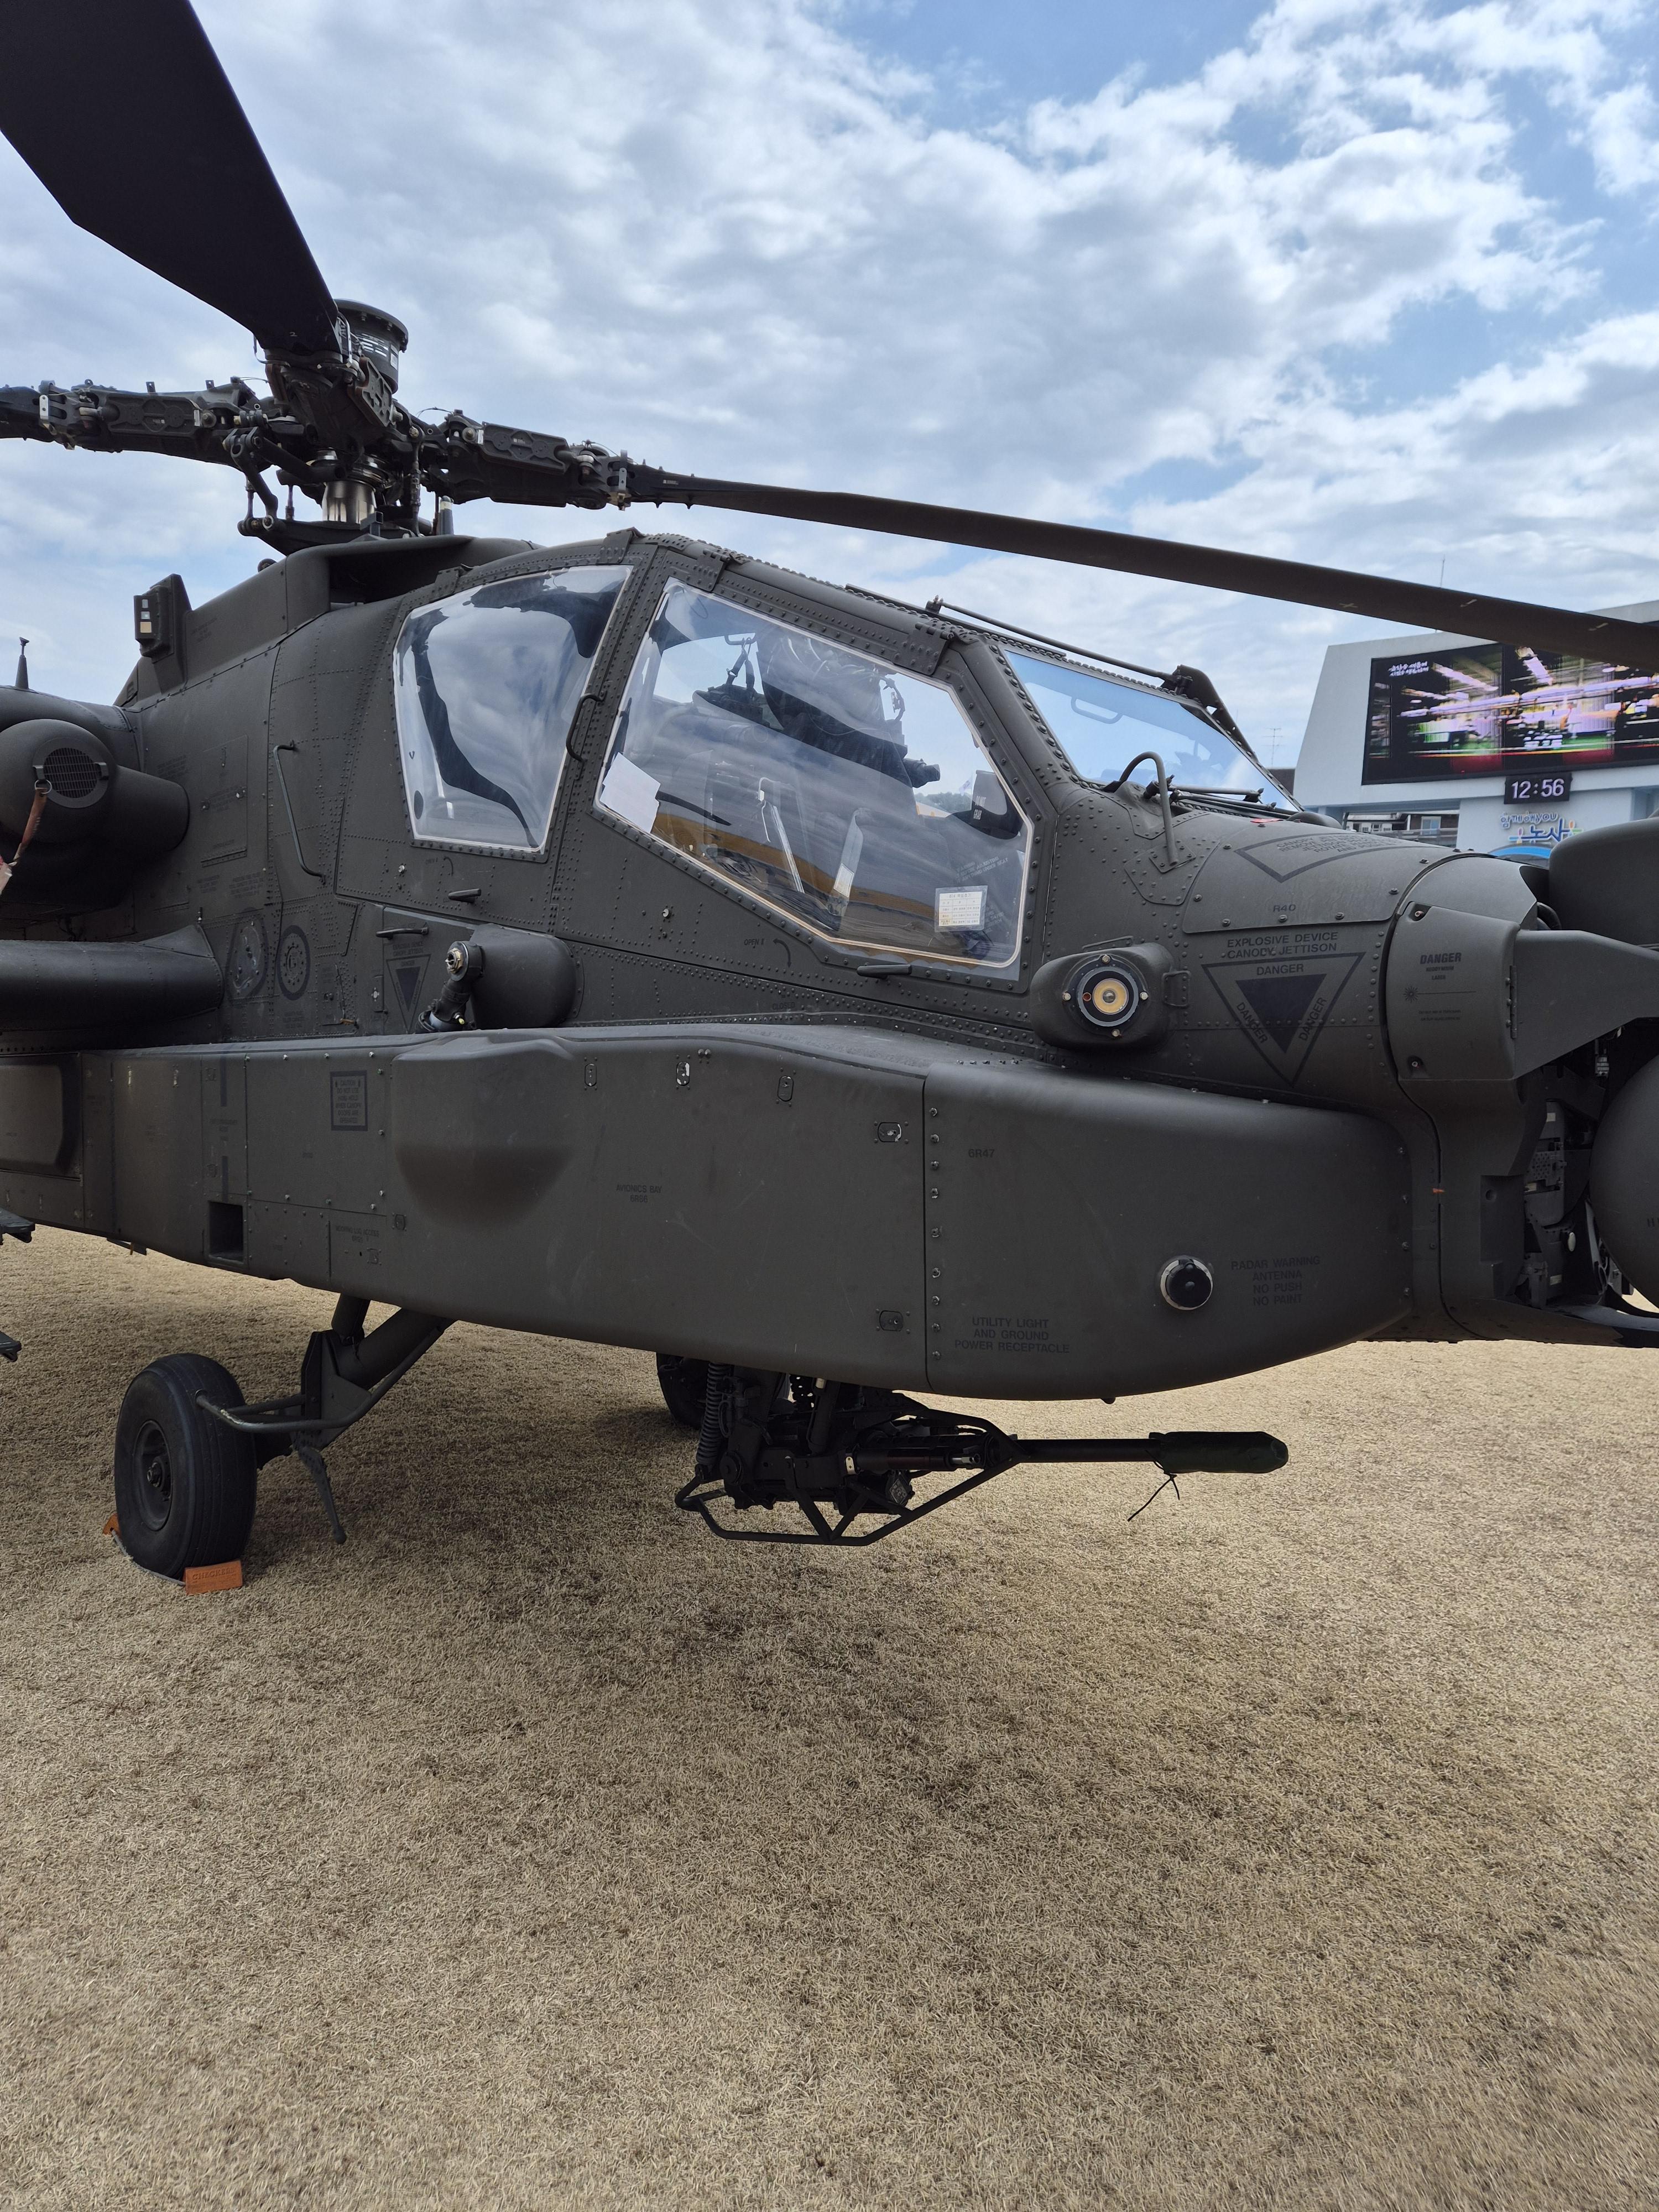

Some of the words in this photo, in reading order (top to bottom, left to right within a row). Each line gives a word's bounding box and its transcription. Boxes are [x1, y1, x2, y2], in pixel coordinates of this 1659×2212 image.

[1511, 778, 1565, 799] 12:56
[1272, 904, 1297, 912] R40
[1227, 935, 1289, 948] EXPLOSIVE
[1295, 932, 1339, 943] DEVICE
[1279, 942, 1337, 956] JETTISON
[1420, 952, 1462, 964] DANGER
[1256, 963, 1305, 975] DANGER
[1237, 1002, 1268, 1044] DANGER
[1299, 997, 1327, 1041] DANGER
[968, 1148, 995, 1159] 6R47
[615, 1183, 648, 1193] AVIONICS
[649, 1185, 662, 1194] BAY
[1231, 1259, 1269, 1270] RADAR
[1272, 1255, 1321, 1268] WARNING
[1252, 1270, 1303, 1281] ANTENNA
[1253, 1283, 1270, 1294] NO
[1274, 1282, 1302, 1292] PUSH
[1253, 1296, 1270, 1306] NO
[1274, 1293, 1303, 1305] PAINT
[972, 1317, 1012, 1327] UTILITY
[1016, 1318, 1050, 1328] LIGHT
[973, 1328, 996, 1339] AND
[1000, 1329, 1050, 1340] GROUND
[954, 1339, 994, 1350] POWER
[998, 1342, 1071, 1354] RECEPTACLE
